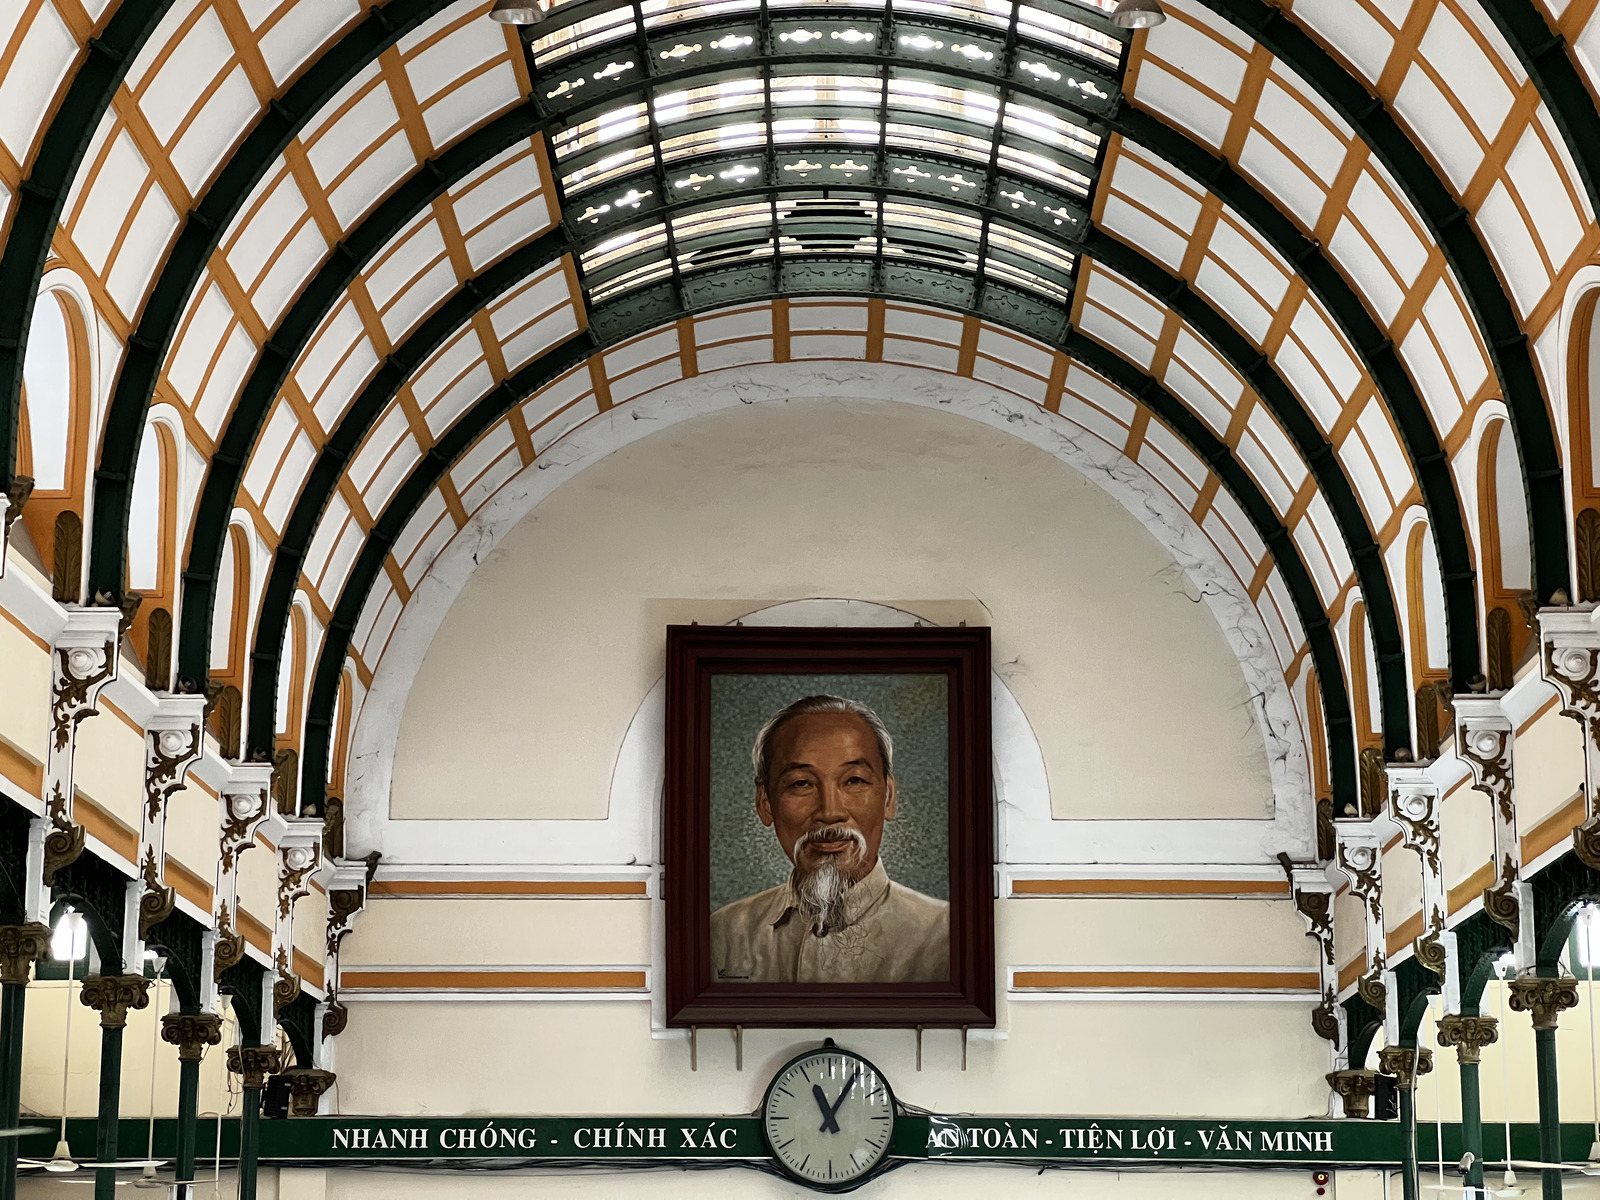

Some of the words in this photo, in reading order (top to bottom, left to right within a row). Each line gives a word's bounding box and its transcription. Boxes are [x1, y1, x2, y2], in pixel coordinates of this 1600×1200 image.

[331, 1128, 429, 1149] NHANH
[439, 1120, 537, 1149] CHÓNG
[573, 1121, 667, 1149] CHÍNH
[679, 1121, 737, 1149] XÁC
[966, 1121, 1039, 1149] TOÀN
[1059, 1122, 1124, 1155] TIỆN
[1129, 1127, 1177, 1156] LỢI
[1197, 1124, 1253, 1151] VĂN
[1259, 1131, 1334, 1152] MINH
